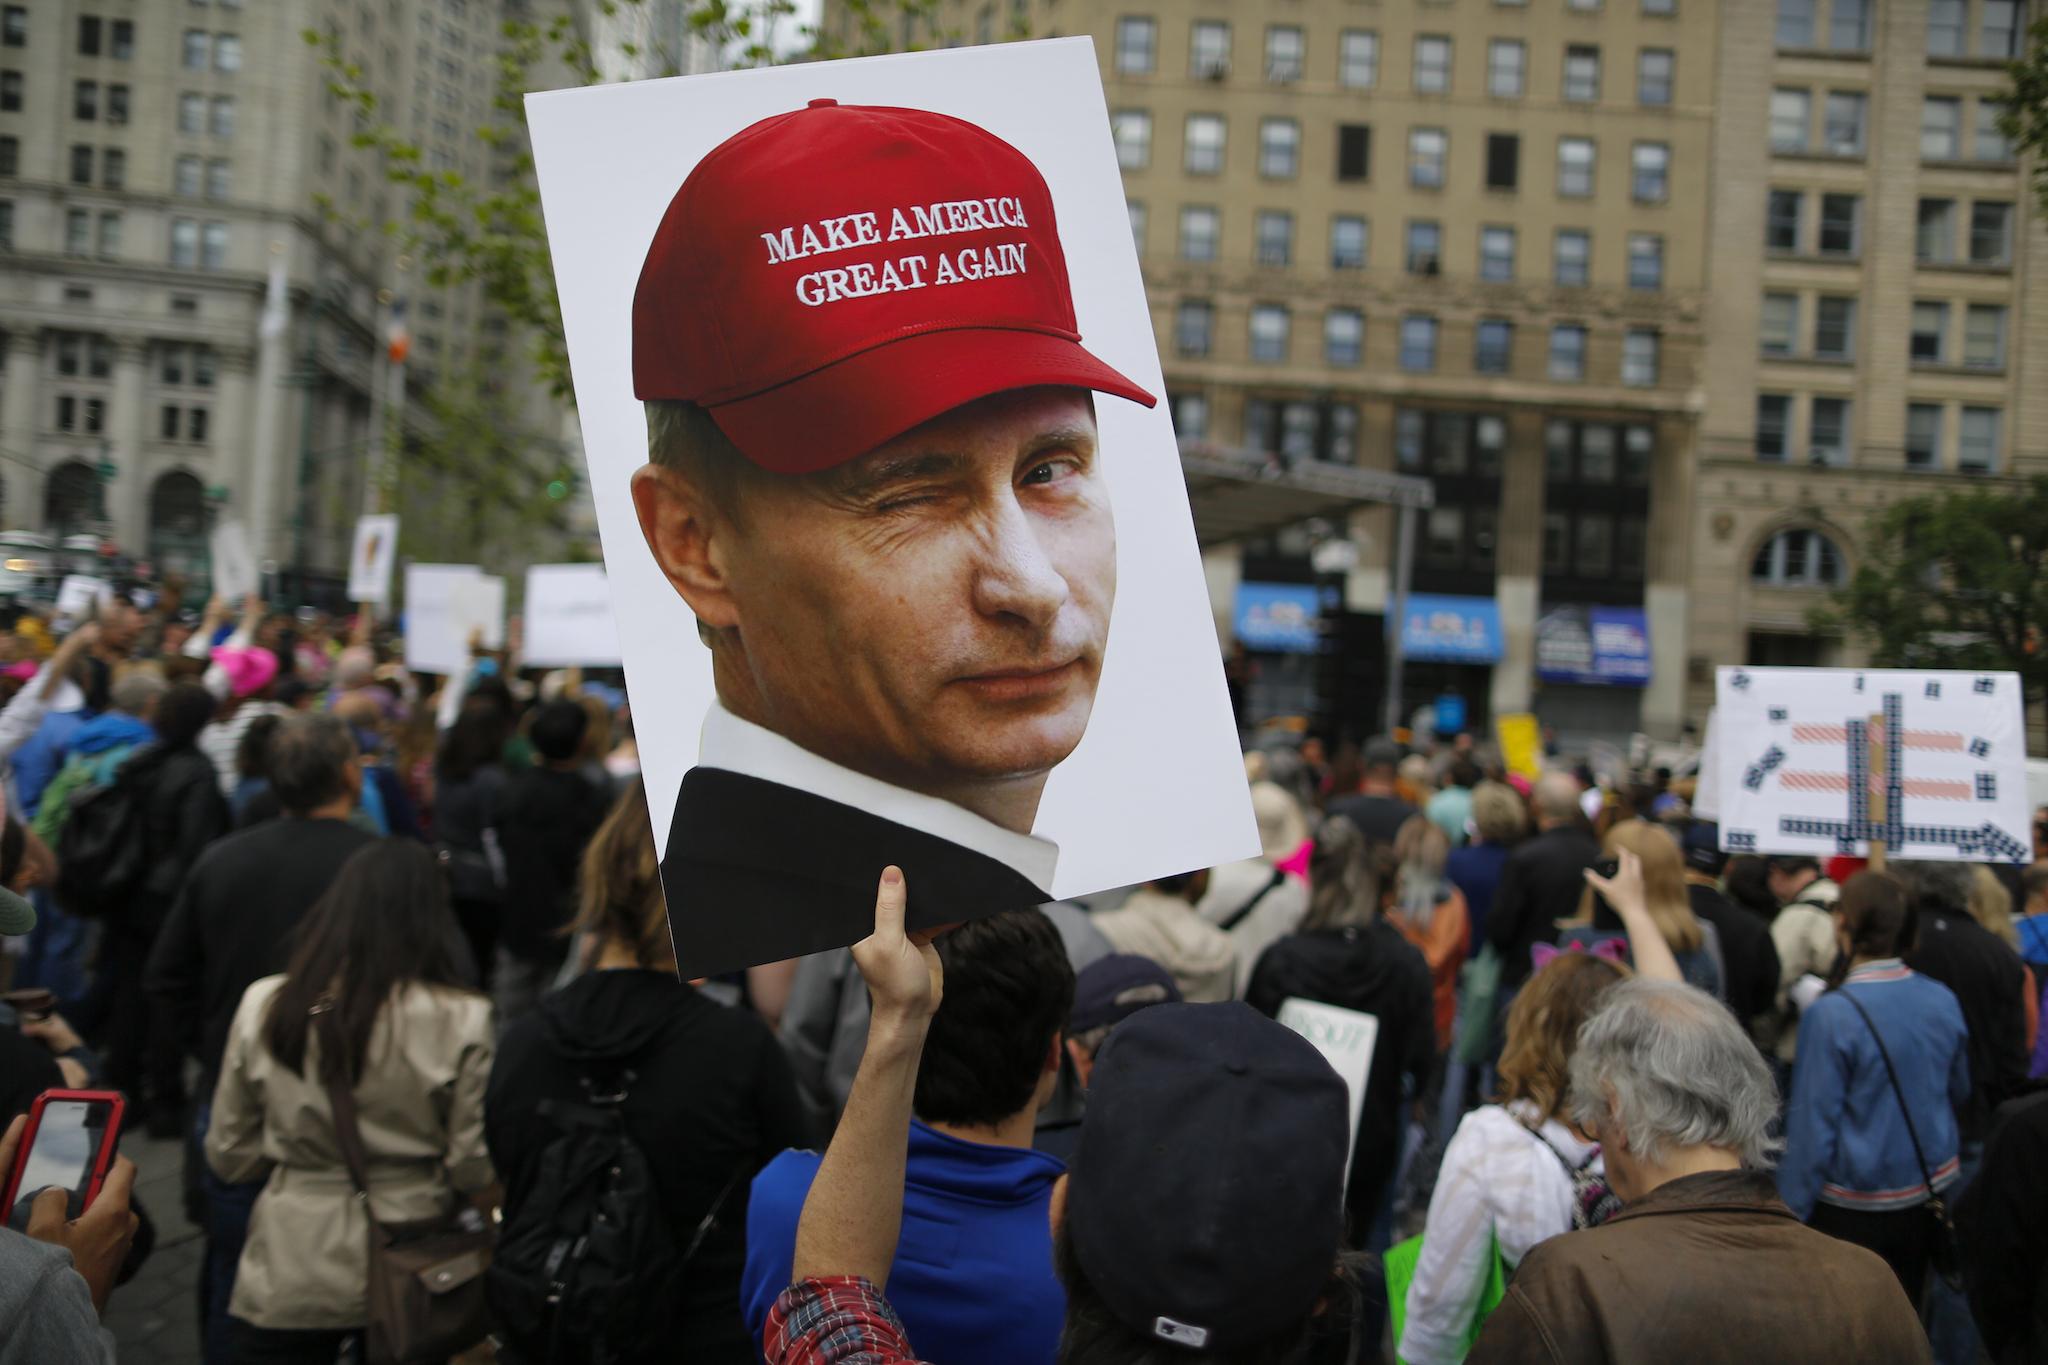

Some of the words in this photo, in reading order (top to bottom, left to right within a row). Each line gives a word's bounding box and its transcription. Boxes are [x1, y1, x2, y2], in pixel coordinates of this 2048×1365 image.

[761, 211, 881, 264] MAKE
[887, 197, 1028, 242] AMERICA
[796, 255, 927, 306] GREAT
[934, 242, 1027, 285] AGAIN
